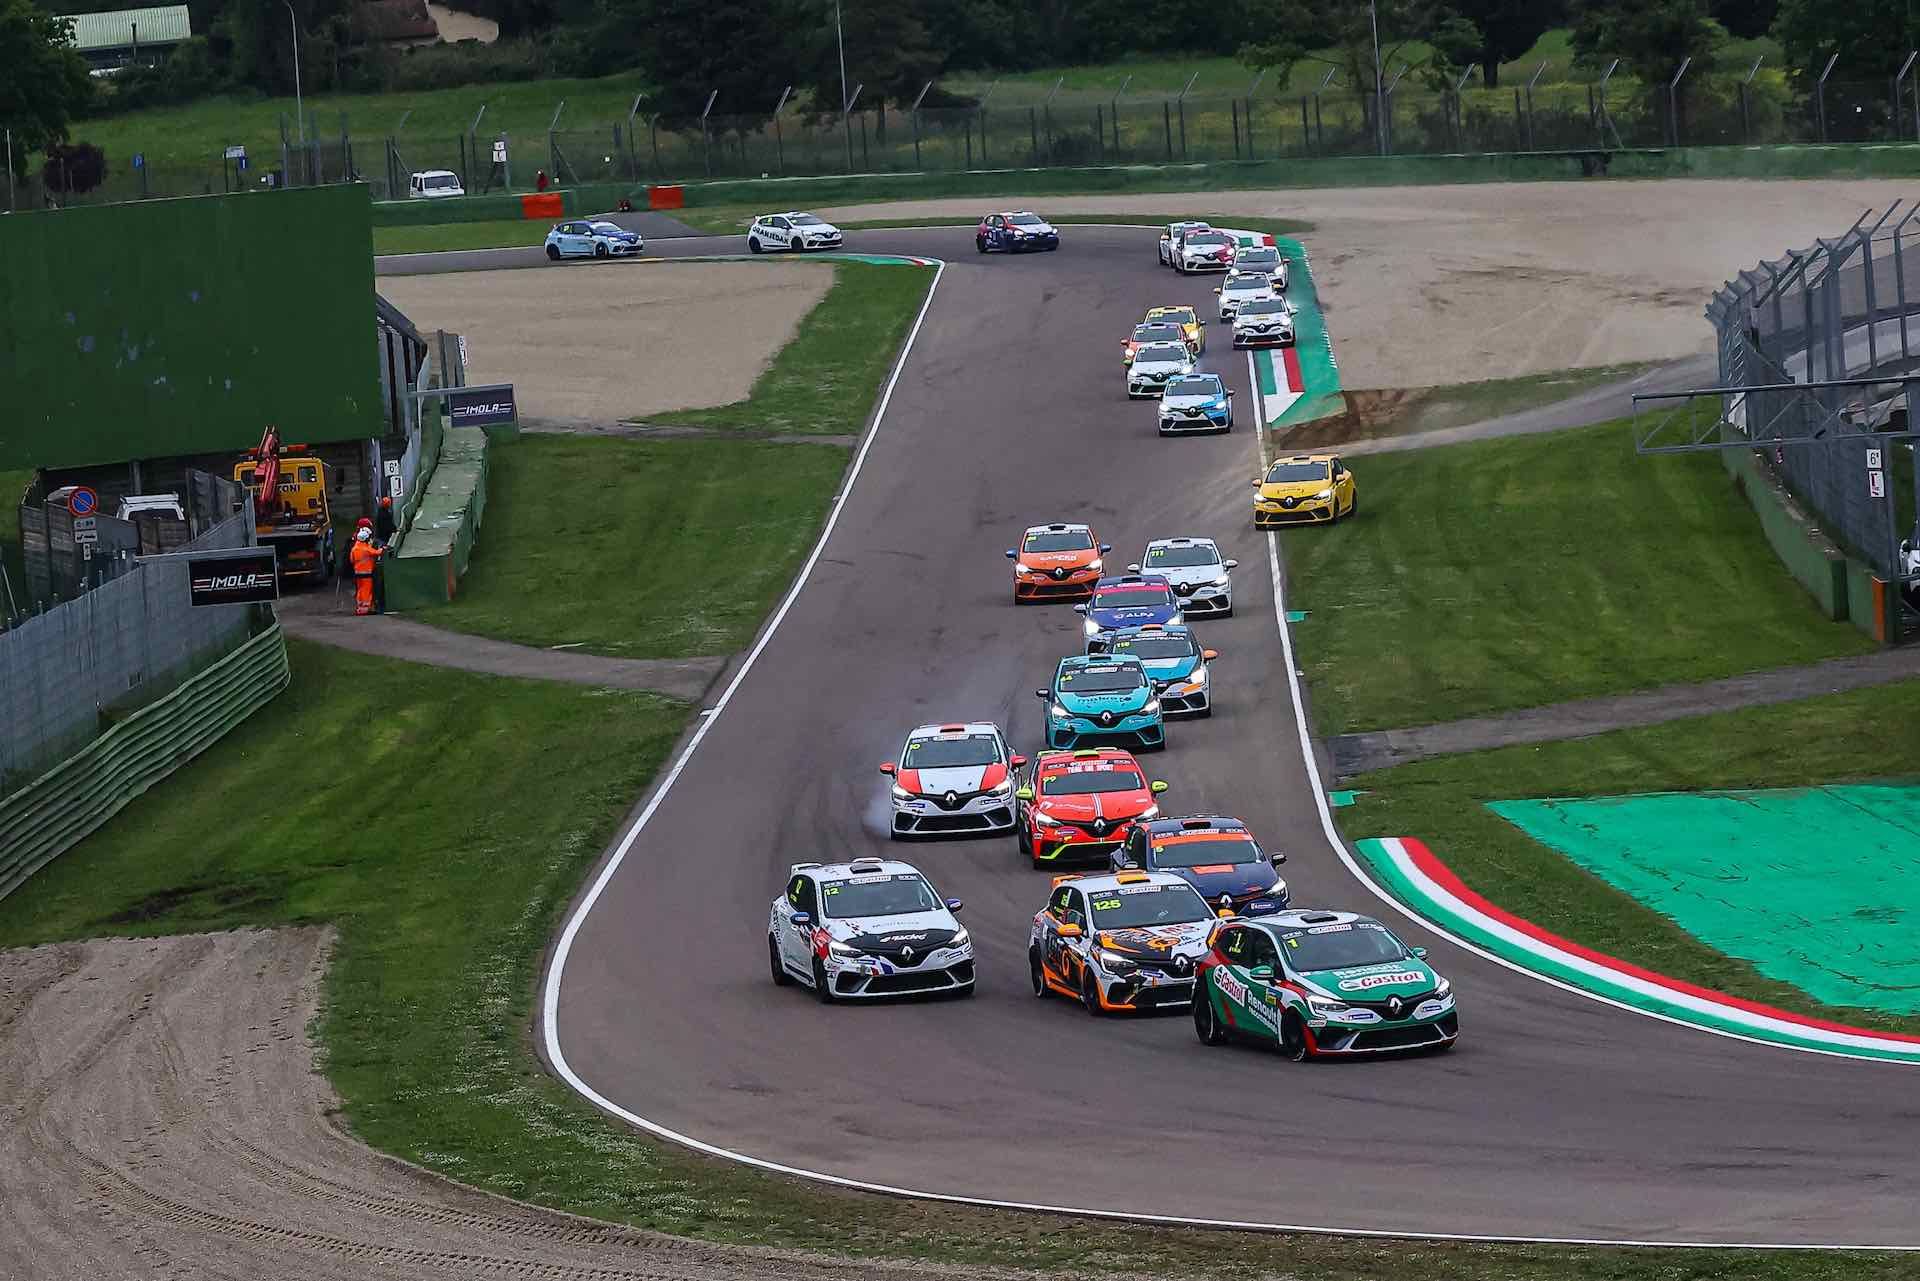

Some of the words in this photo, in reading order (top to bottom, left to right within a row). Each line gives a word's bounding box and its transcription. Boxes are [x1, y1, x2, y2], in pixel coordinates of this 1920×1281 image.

[466, 403, 499, 414] IMOLA
[210, 573, 256, 589] IMOLA
[823, 887, 840, 896] 12
[1093, 899, 1122, 911] 125
[1220, 972, 1246, 1004] Castrol
[1360, 972, 1422, 988] Castrol
[1247, 989, 1282, 1024] Renault
